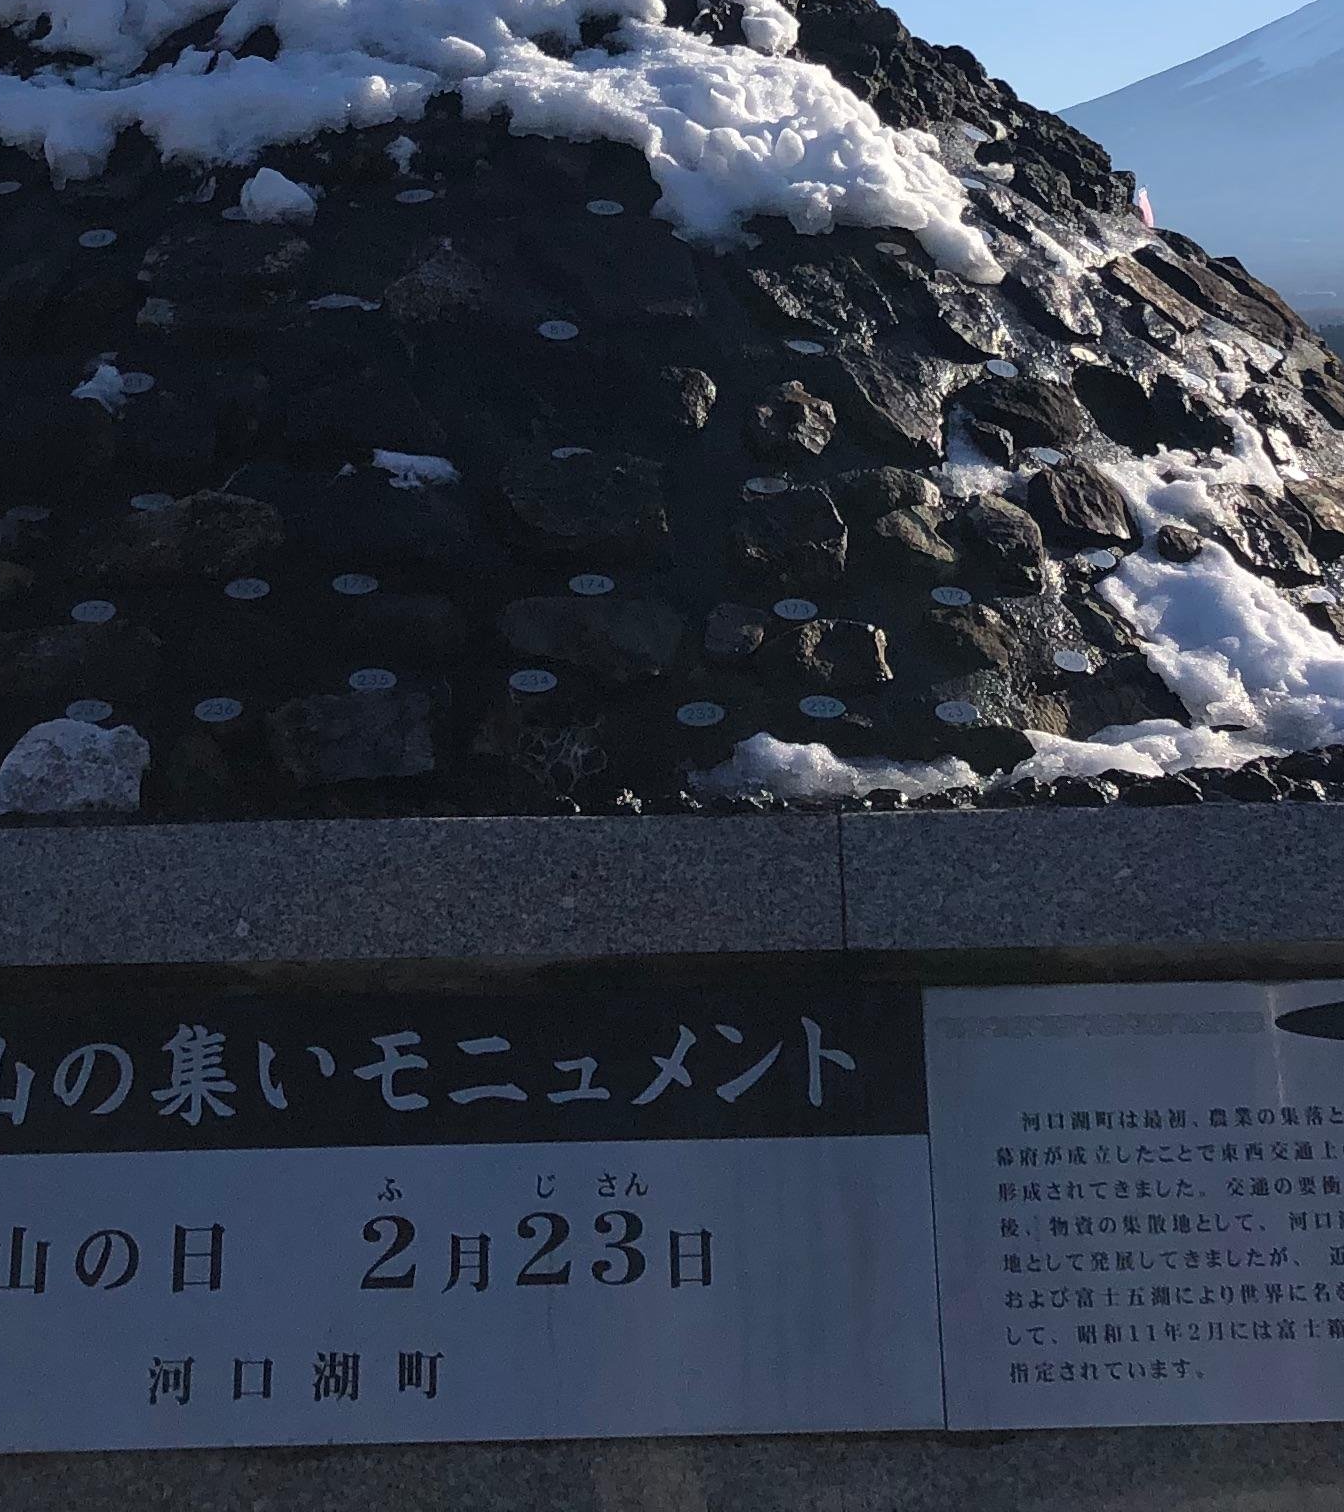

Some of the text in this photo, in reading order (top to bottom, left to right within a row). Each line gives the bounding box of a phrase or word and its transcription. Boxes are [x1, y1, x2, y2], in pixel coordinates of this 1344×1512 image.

[376, 1171, 650, 1202] ふ じ さん
[361, 1208, 716, 1294] 2月23日
[148, 1349, 445, 1406] 河口湖町
[1010, 1359, 1206, 1384] 指定されています。
